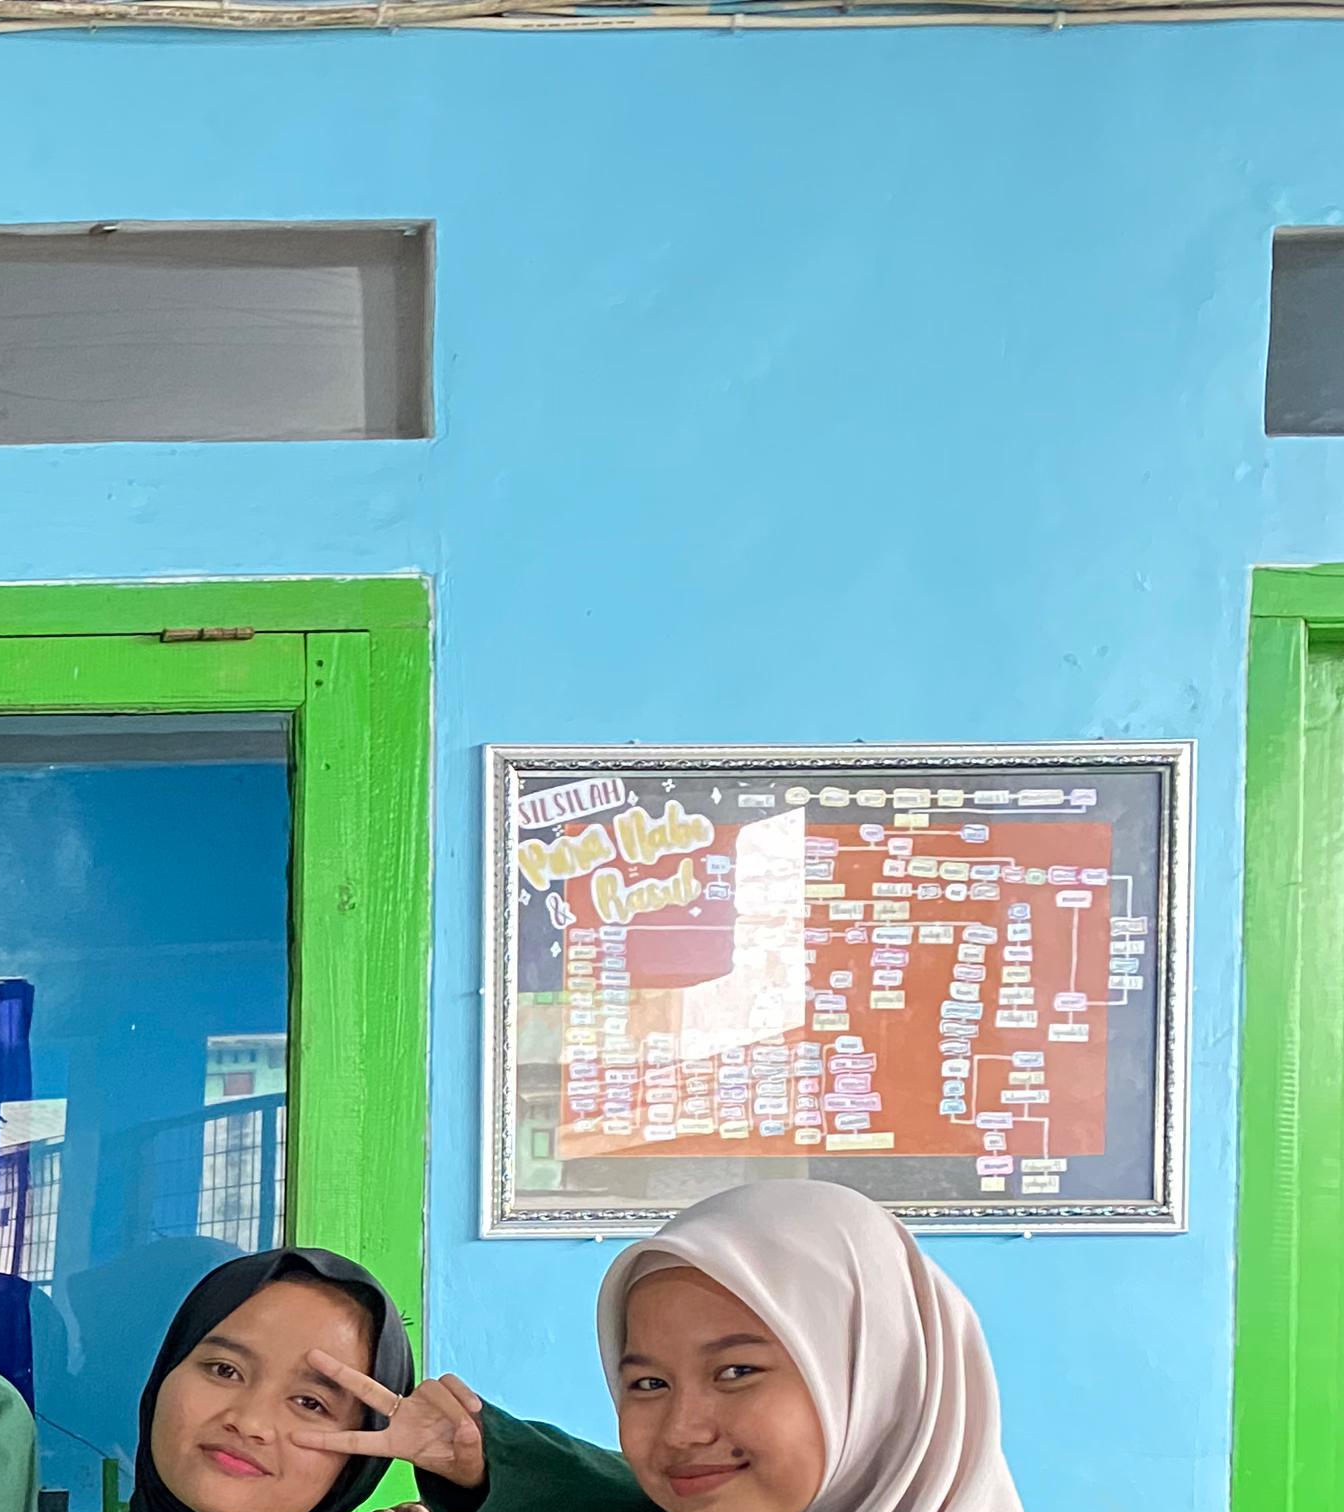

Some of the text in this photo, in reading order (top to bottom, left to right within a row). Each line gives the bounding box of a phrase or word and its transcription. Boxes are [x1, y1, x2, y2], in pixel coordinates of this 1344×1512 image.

[518, 779, 622, 824] SILSILAH
[518, 829, 610, 889] Para
[549, 894, 574, 926] &
[595, 858, 699, 923] Rasul
